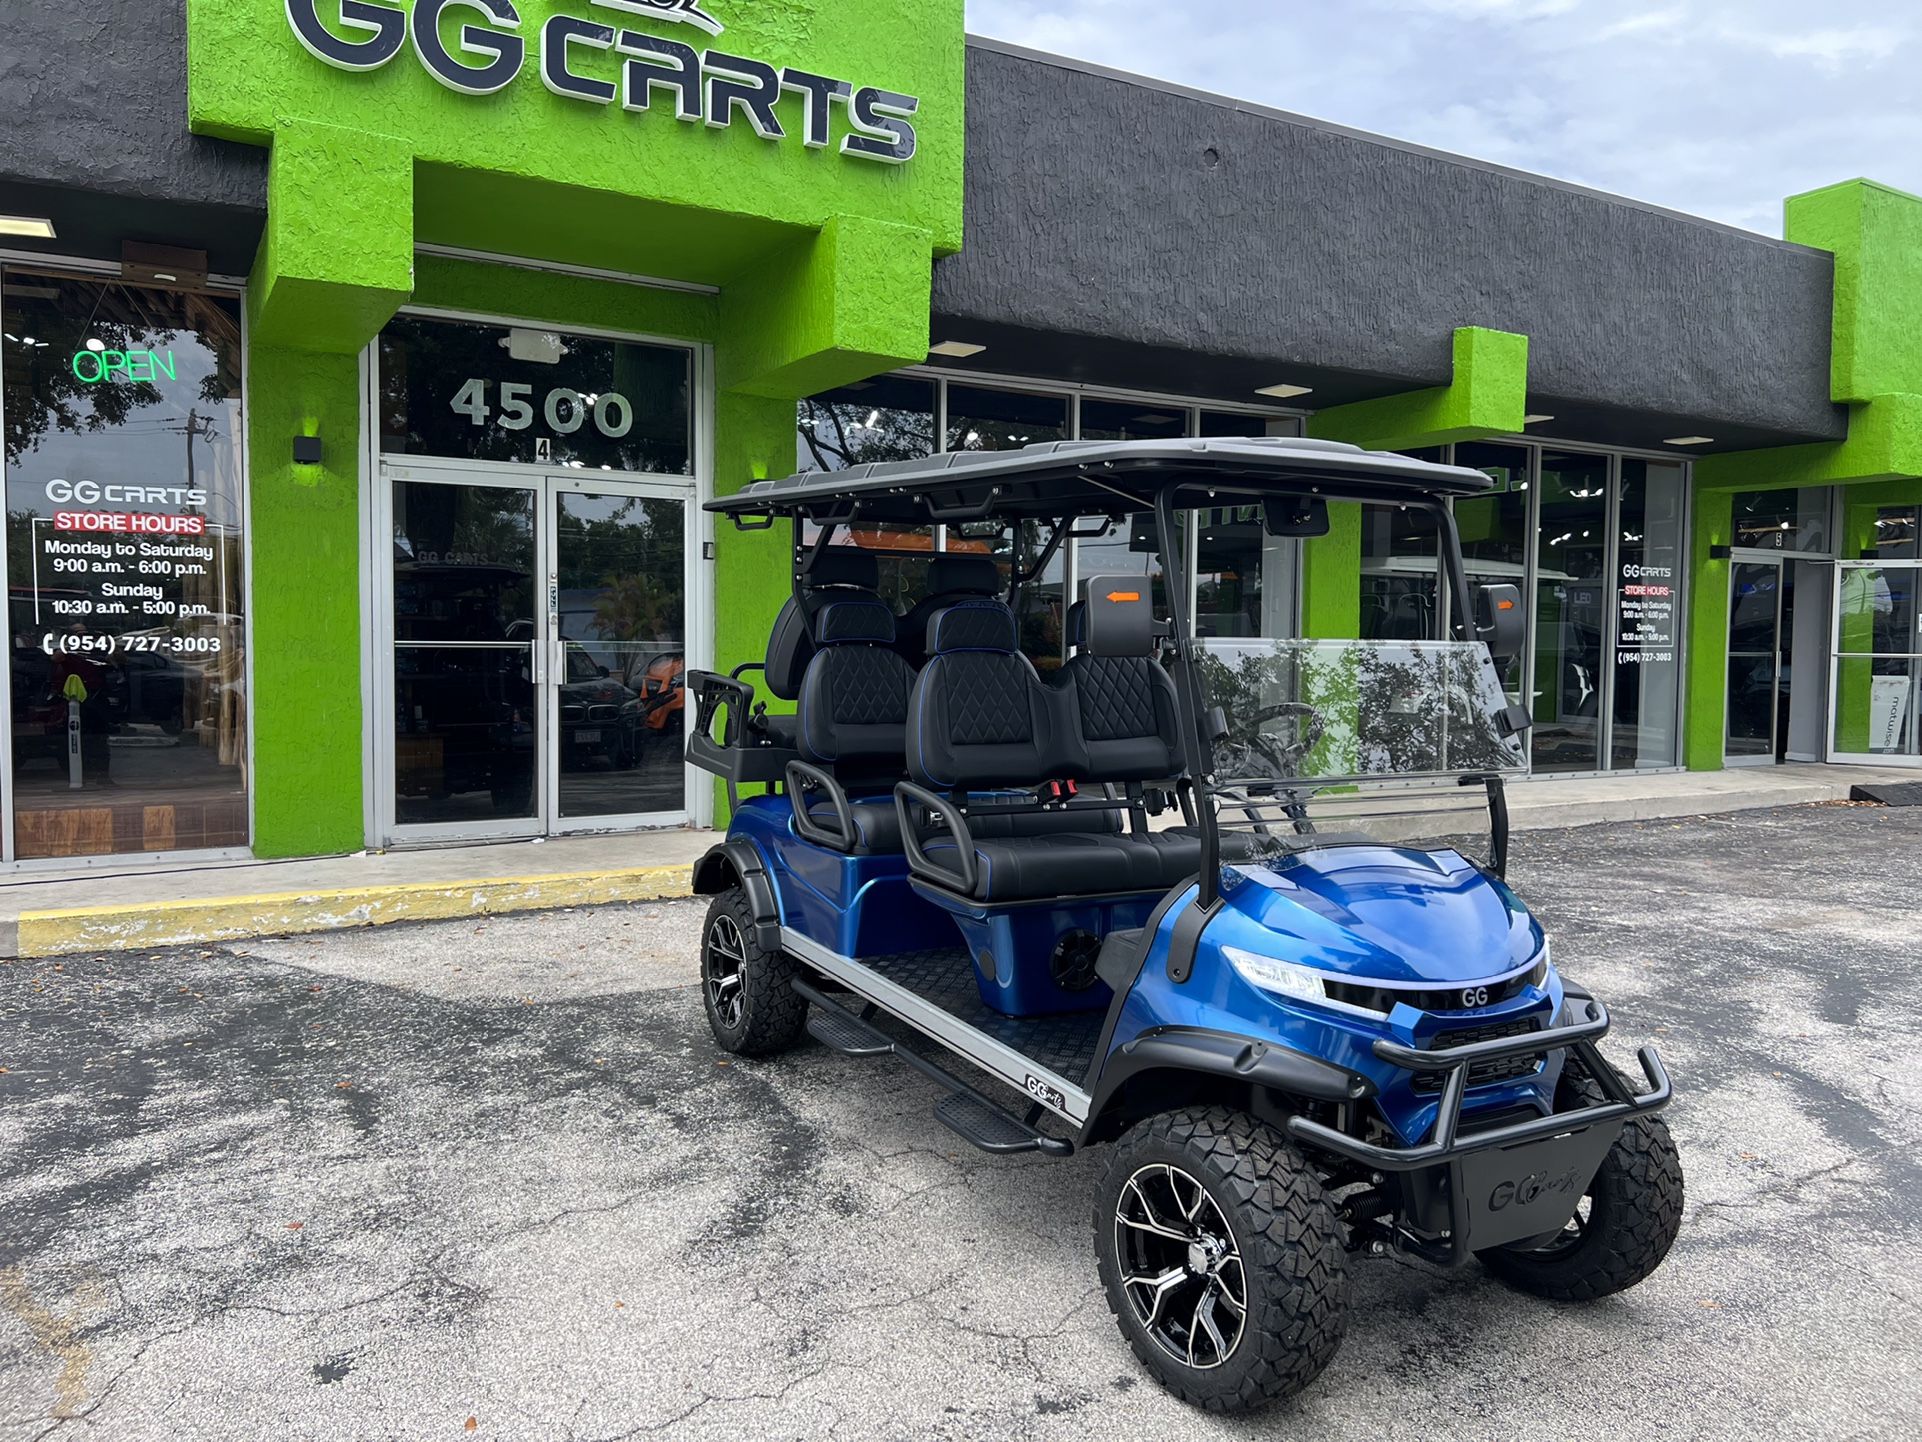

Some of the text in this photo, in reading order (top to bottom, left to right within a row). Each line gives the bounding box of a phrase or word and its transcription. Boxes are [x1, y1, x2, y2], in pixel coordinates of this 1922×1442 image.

[284, 0, 919, 164] GG CARTS
[73, 350, 176, 382] OPEN
[450, 378, 634, 438] 4500
[537, 440, 549, 461] 4
[45, 479, 207, 506] GG CARTS
[57, 512, 202, 533] STORE HOURS
[45, 540, 214, 560] Monday to Saturday
[53, 559, 87, 573] 9:00
[92, 561, 125, 574] a.m.
[139, 561, 171, 575] 6:00
[175, 563, 207, 577] p.m.
[1623, 564, 1672, 578] GG CARTS
[102, 582, 163, 600] Sunday
[1625, 585, 1669, 596] STORE HOURS
[52, 600, 92, 614] 10:30
[96, 602, 129, 614] a.m.
[143, 602, 175, 615] 5:00
[179, 604, 211, 618] p.m.
[1621, 601, 1641, 610] Monday
[1649, 601, 1671, 611] Saturday
[1636, 624, 1655, 633] Sunday
[60, 634, 221, 655] (954) 727-3003
[1622, 653, 1672, 663] (954) 727-3003
[1884, 696, 1899, 747] matwise
[1462, 986, 1488, 1007] GG
